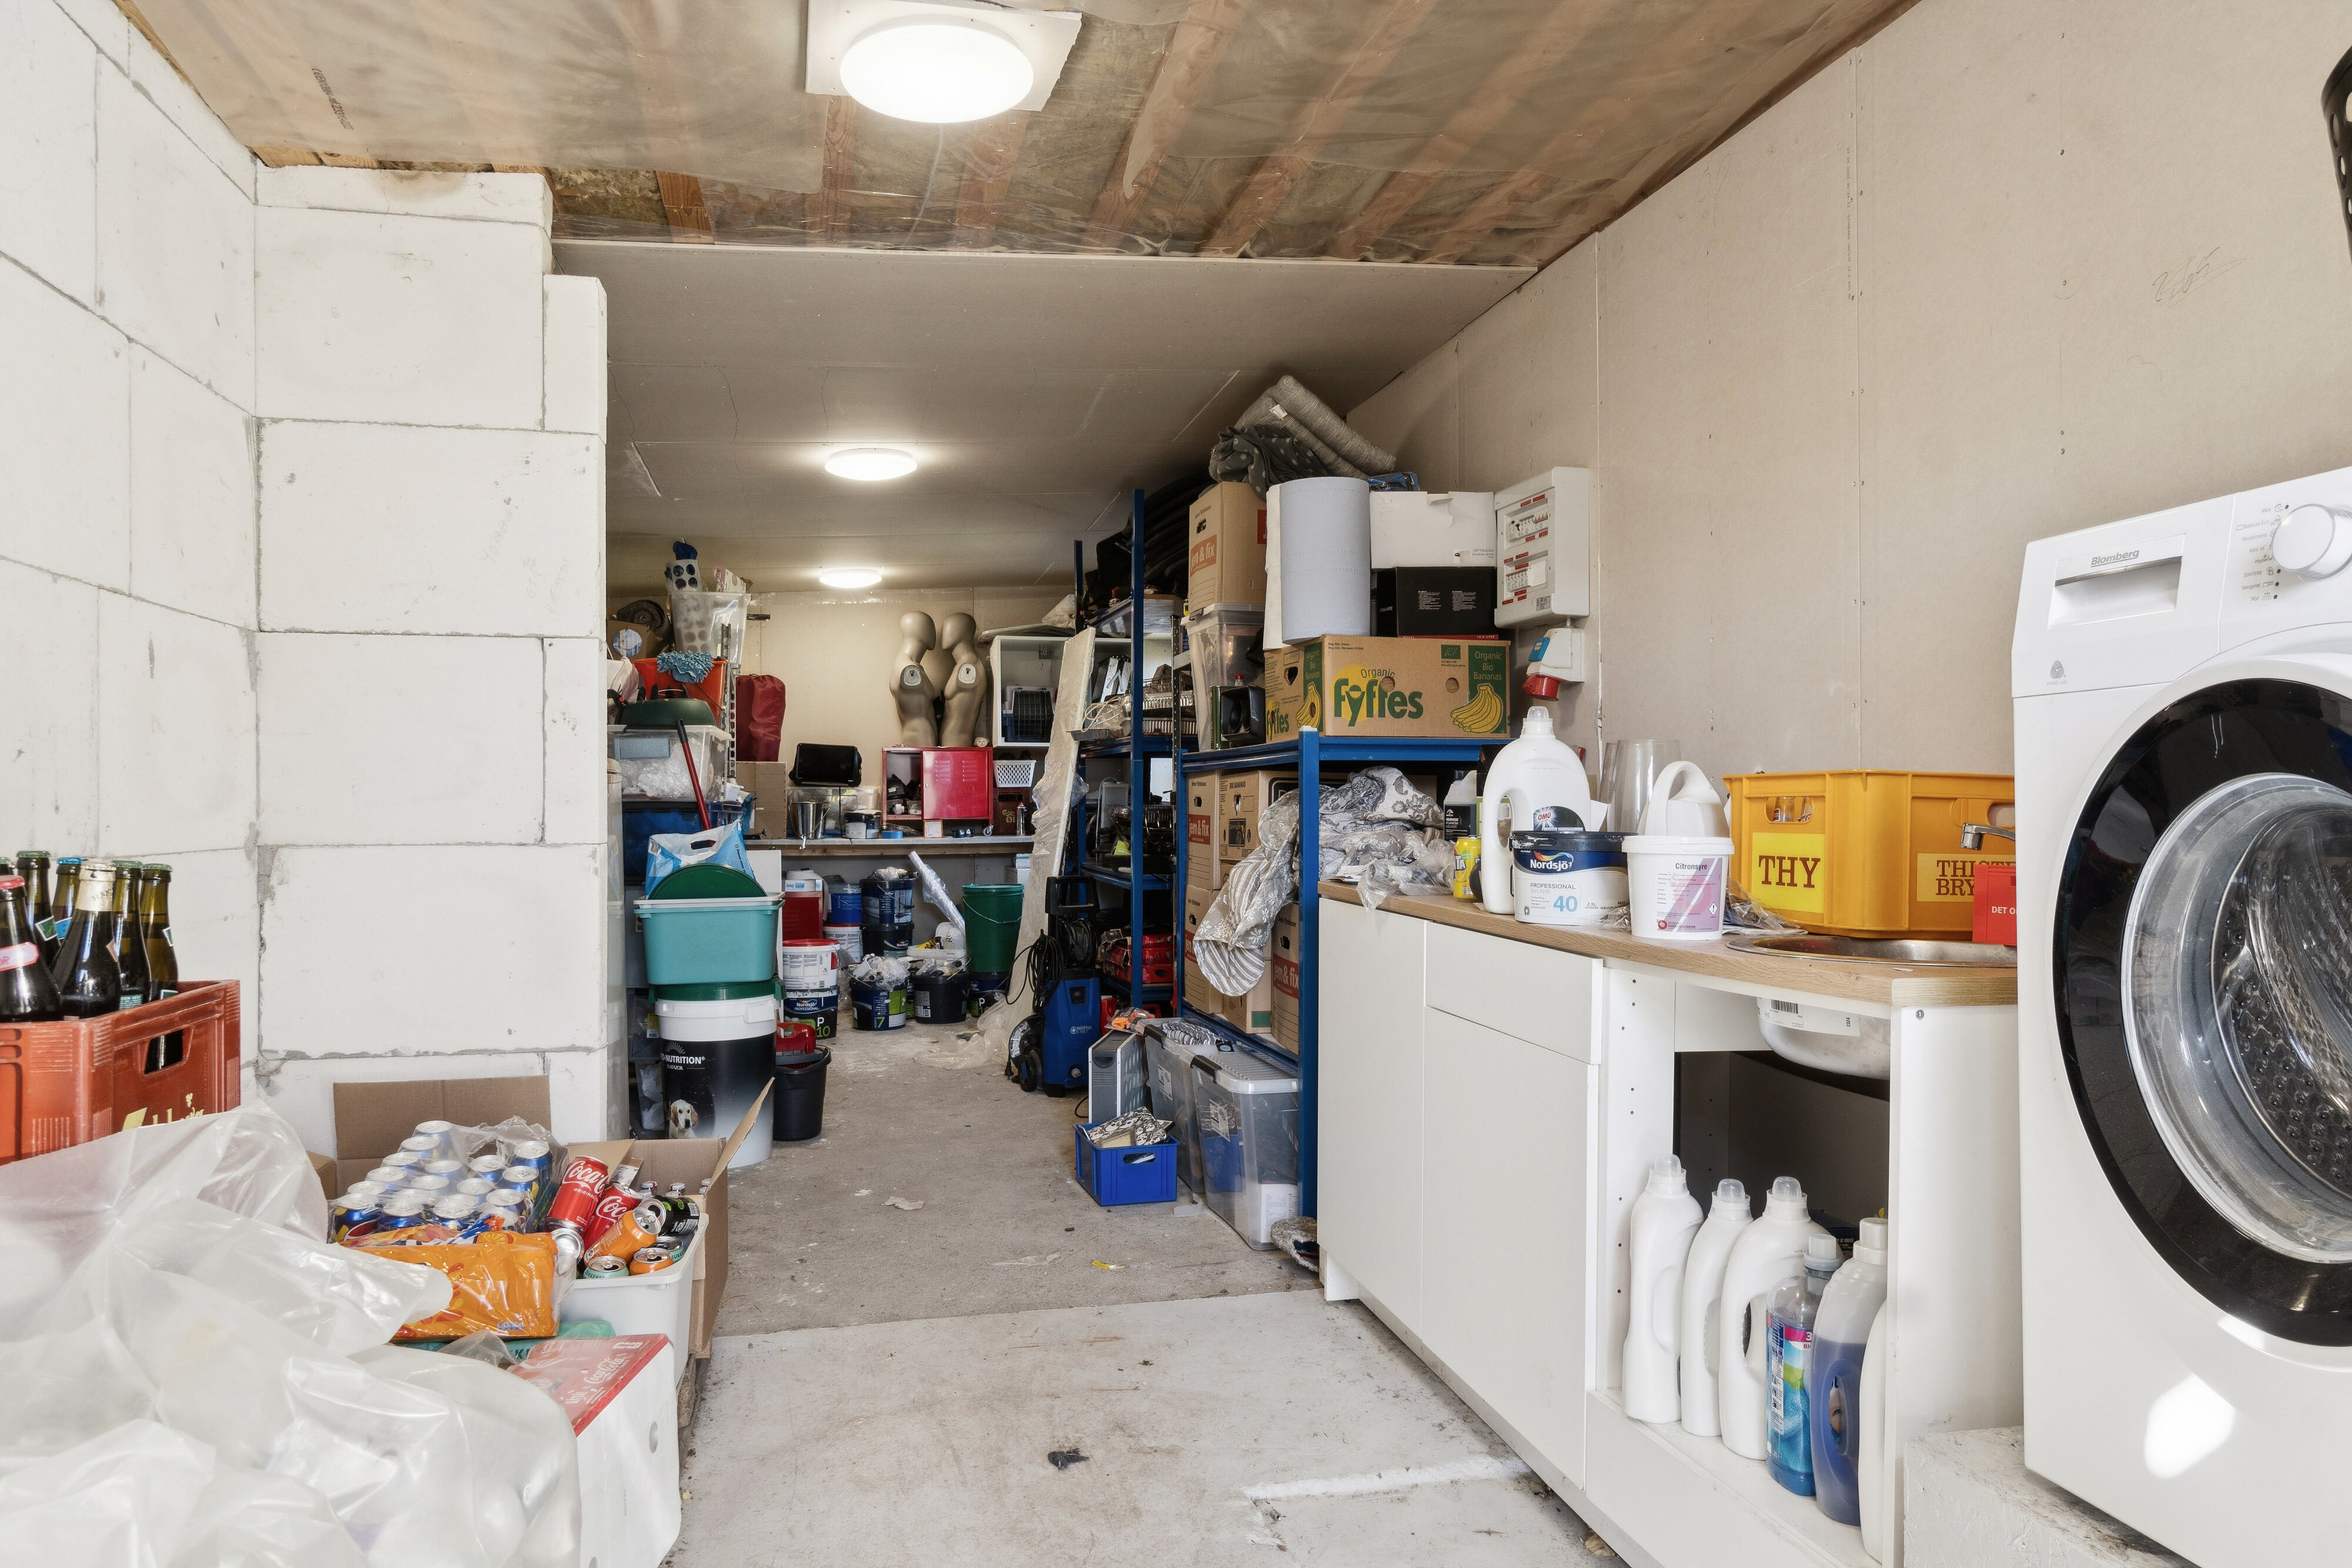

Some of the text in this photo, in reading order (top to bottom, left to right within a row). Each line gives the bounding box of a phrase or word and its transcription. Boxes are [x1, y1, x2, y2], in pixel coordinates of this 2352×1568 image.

[2091, 550, 2140, 568] Blomberg
[1475, 651, 1501, 661] Organic
[1482, 662, 1494, 672] Bio
[1360, 668, 1396, 680] Organic
[1473, 671, 1502, 681] Bananas
[1537, 812, 1552, 821] OMO
[1189, 819, 1197, 837] jem
[1530, 858, 1569, 872] Nordsjö
[1675, 862, 1708, 871] Citronsyre
[1759, 855, 1820, 888] THY
[1936, 878, 1974, 896] BRY
[1553, 895, 1578, 913] 40
[1991, 906, 2007, 915] DET
[1273, 959, 1283, 982] jem
[1283, 965, 1289, 985] &
[978, 997, 985, 1007] P
[817, 1017, 825, 1027] P
[877, 1017, 885, 1028] 7
[816, 1025, 830, 1038] 10
